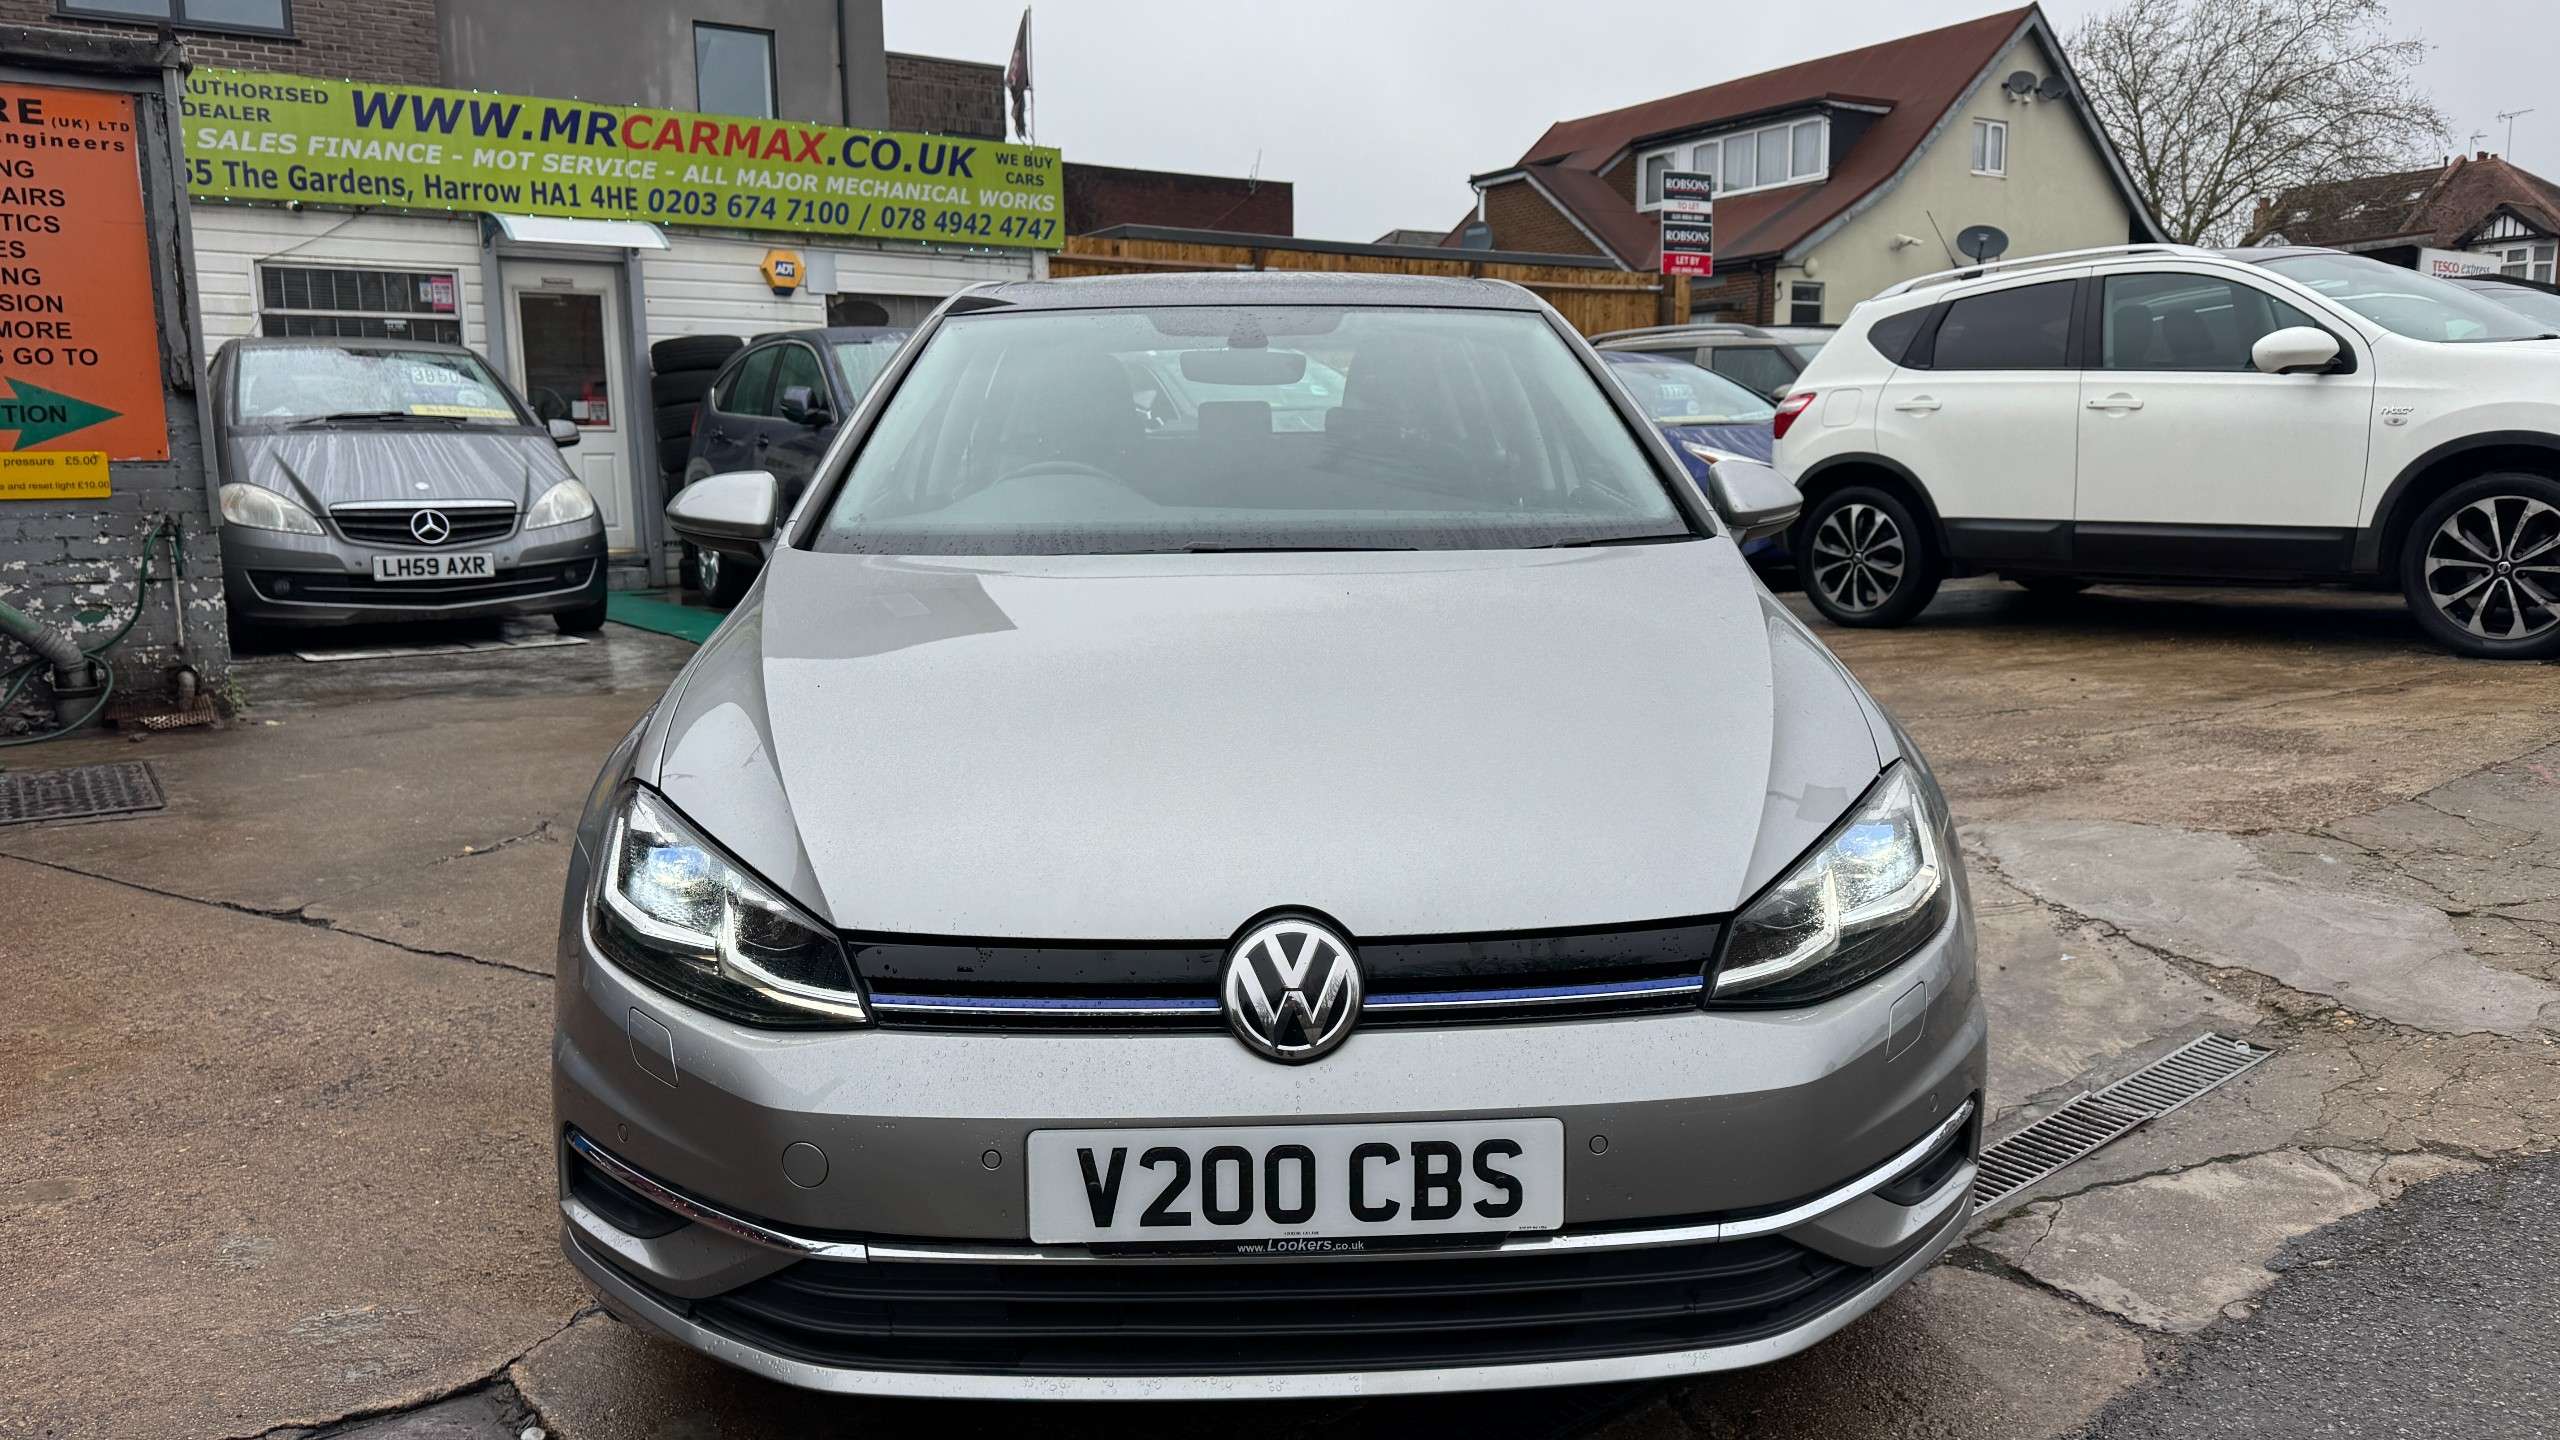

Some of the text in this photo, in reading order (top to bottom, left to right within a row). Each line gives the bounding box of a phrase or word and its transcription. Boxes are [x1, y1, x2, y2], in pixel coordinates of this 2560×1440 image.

[181, 102, 272, 123] DEALER
[51, 117, 90, 132] (UK)
[98, 121, 130, 132] LTD
[0, 132, 125, 152] ngineers
[351, 90, 976, 178] WWW.MRCARMAX.CO.UK
[995, 152, 1053, 169] WE BUY
[197, 128, 297, 155] SALES
[307, 136, 442, 165] FINANCE
[472, 149, 535, 171] MOT
[542, 154, 657, 179] SERVICE
[683, 164, 728, 186] ALL
[736, 168, 818, 192] MAJOR
[826, 176, 970, 205] MECHANICAL
[978, 189, 1055, 212] WORKS
[1006, 172, 1044, 187] CARS
[1665, 178, 1709, 192] ROBSONS
[1, 187, 65, 207] AIRS
[222, 160, 278, 189] The
[288, 164, 413, 203] Gardens,
[424, 174, 520, 204] Harrow
[530, 181, 581, 207] HA1
[590, 185, 638, 211] 4HE
[647, 188, 717, 216] 0203
[727, 194, 776, 221] 674
[786, 198, 849, 225] 7100
[857, 204, 871, 231] /
[881, 206, 926, 231] 078
[934, 211, 992, 236] 4942
[1000, 216, 1057, 240] 4747
[0, 213, 60, 233] TICS
[1665, 230, 1709, 242] ROBSONS
[776, 262, 794, 276] ADT
[2432, 260, 2459, 273] TESCO
[1, 268, 41, 286] NG
[13, 348, 54, 365] GO
[62, 349, 98, 366] TO
[1, 405, 67, 422] TION
[3, 455, 98, 468] pressure £5.00
[382, 556, 486, 577] LH59 AXR
[1076, 1139, 1523, 1228] V200 CBS
[1236, 1239, 1364, 1253] www.Lookers.co.uk
